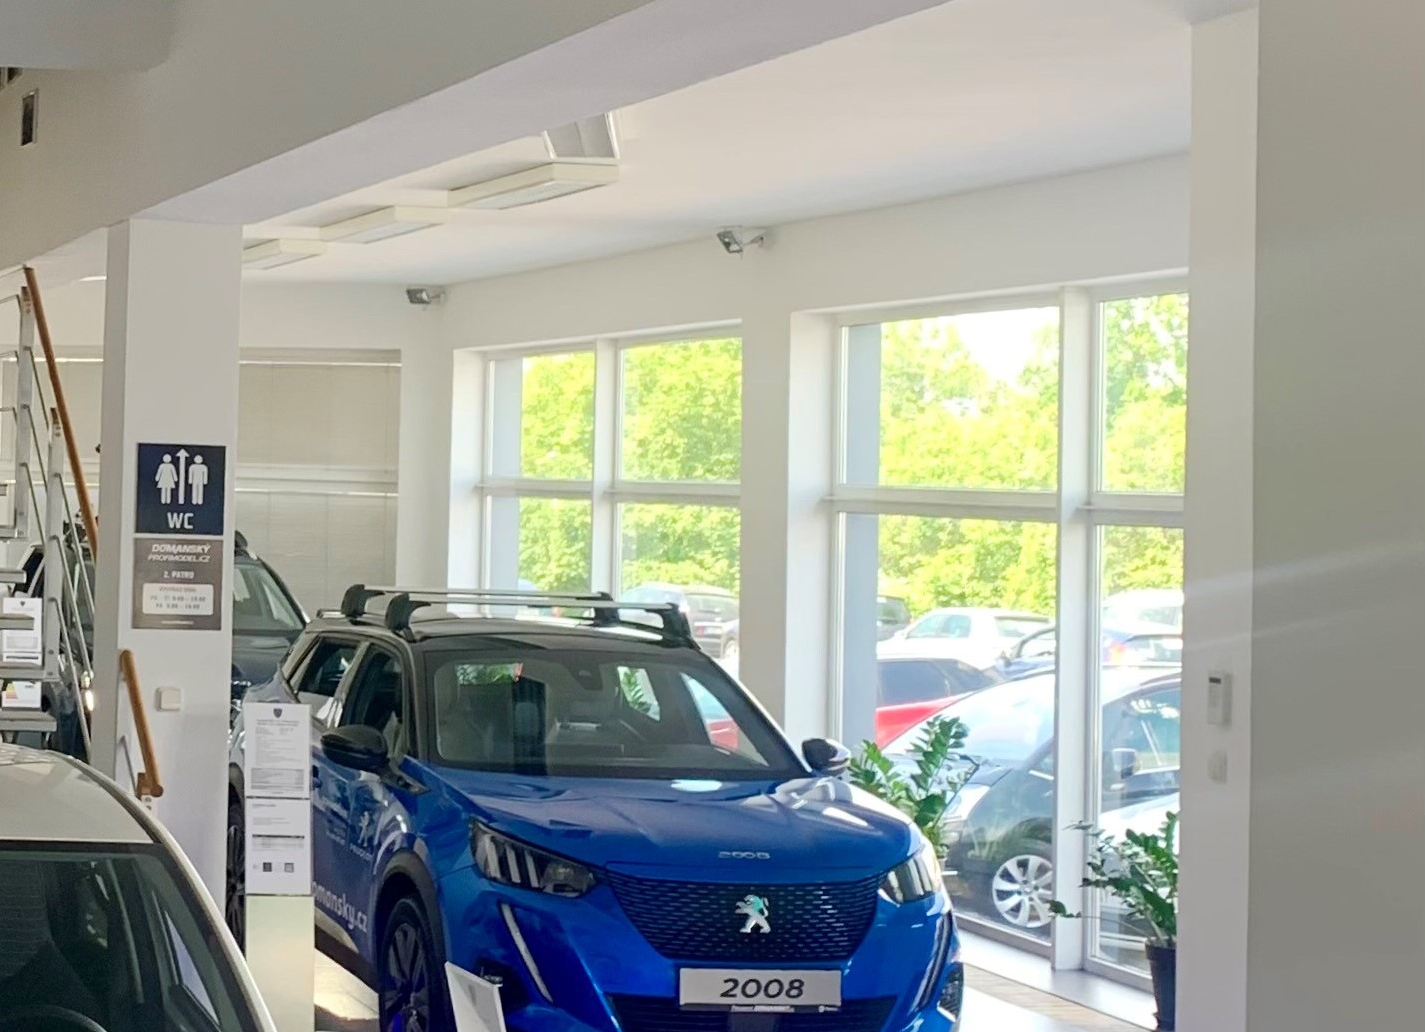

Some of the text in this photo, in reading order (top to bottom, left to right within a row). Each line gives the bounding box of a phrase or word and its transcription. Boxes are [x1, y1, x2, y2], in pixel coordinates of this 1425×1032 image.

[167, 512, 194, 529] WC
[311, 880, 368, 933] omansky.cz
[719, 977, 805, 999] 2008
